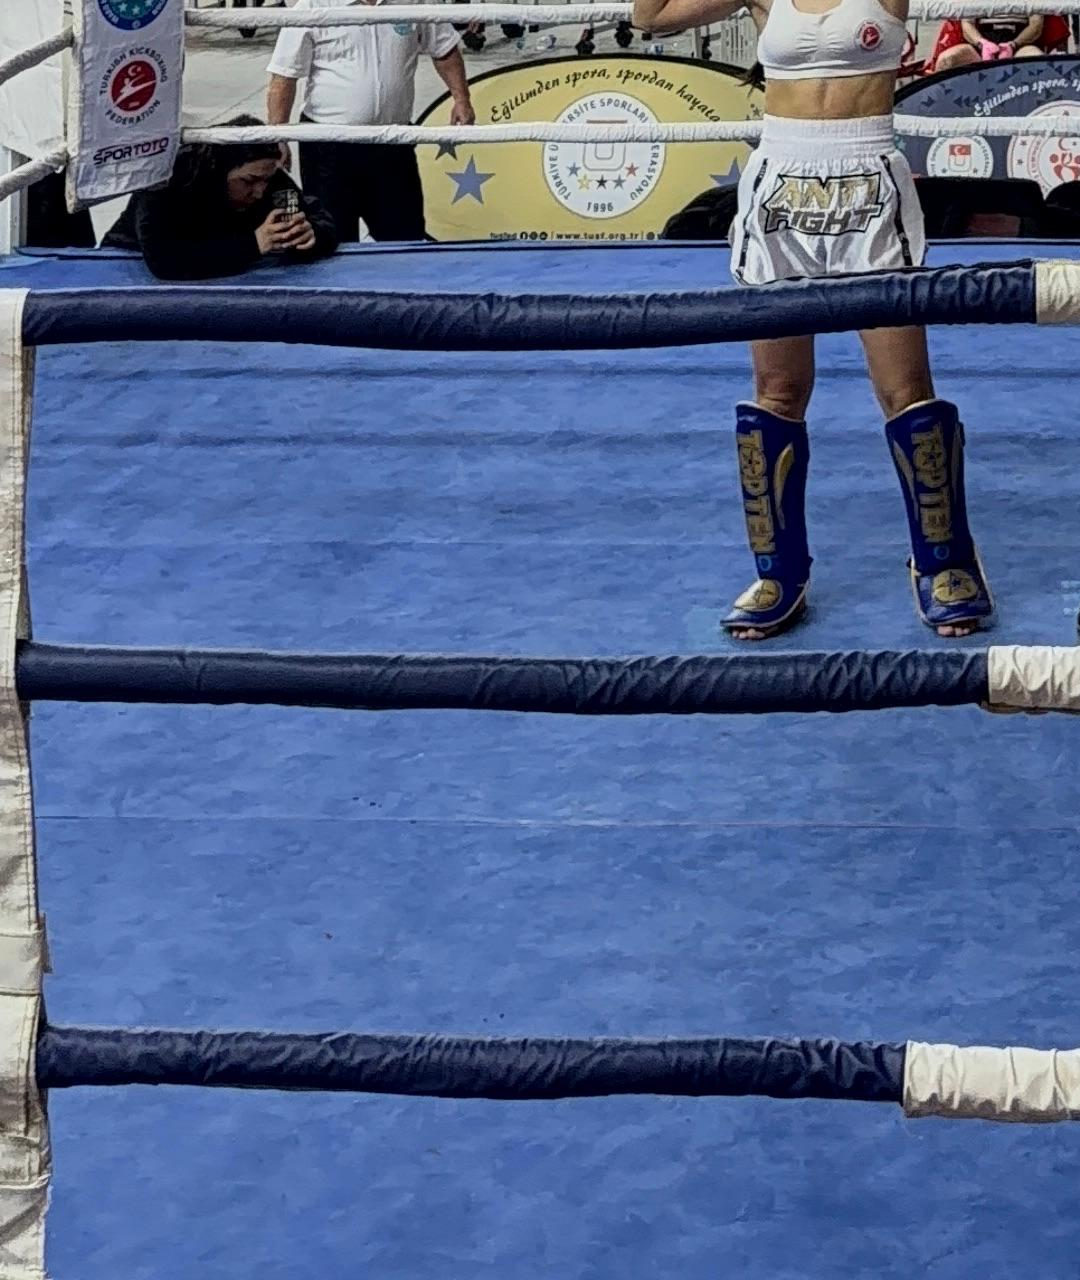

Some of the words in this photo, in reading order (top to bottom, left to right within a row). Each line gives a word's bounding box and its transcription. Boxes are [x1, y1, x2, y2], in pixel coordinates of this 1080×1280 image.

[100, 53, 127, 95] TURKISH
[129, 46, 168, 83] KICKBOXING
[616, 69, 674, 92] spordan
[105, 99, 160, 125] FEDERATION
[768, 206, 880, 233] FIGHT
[744, 495, 776, 554] TEN
